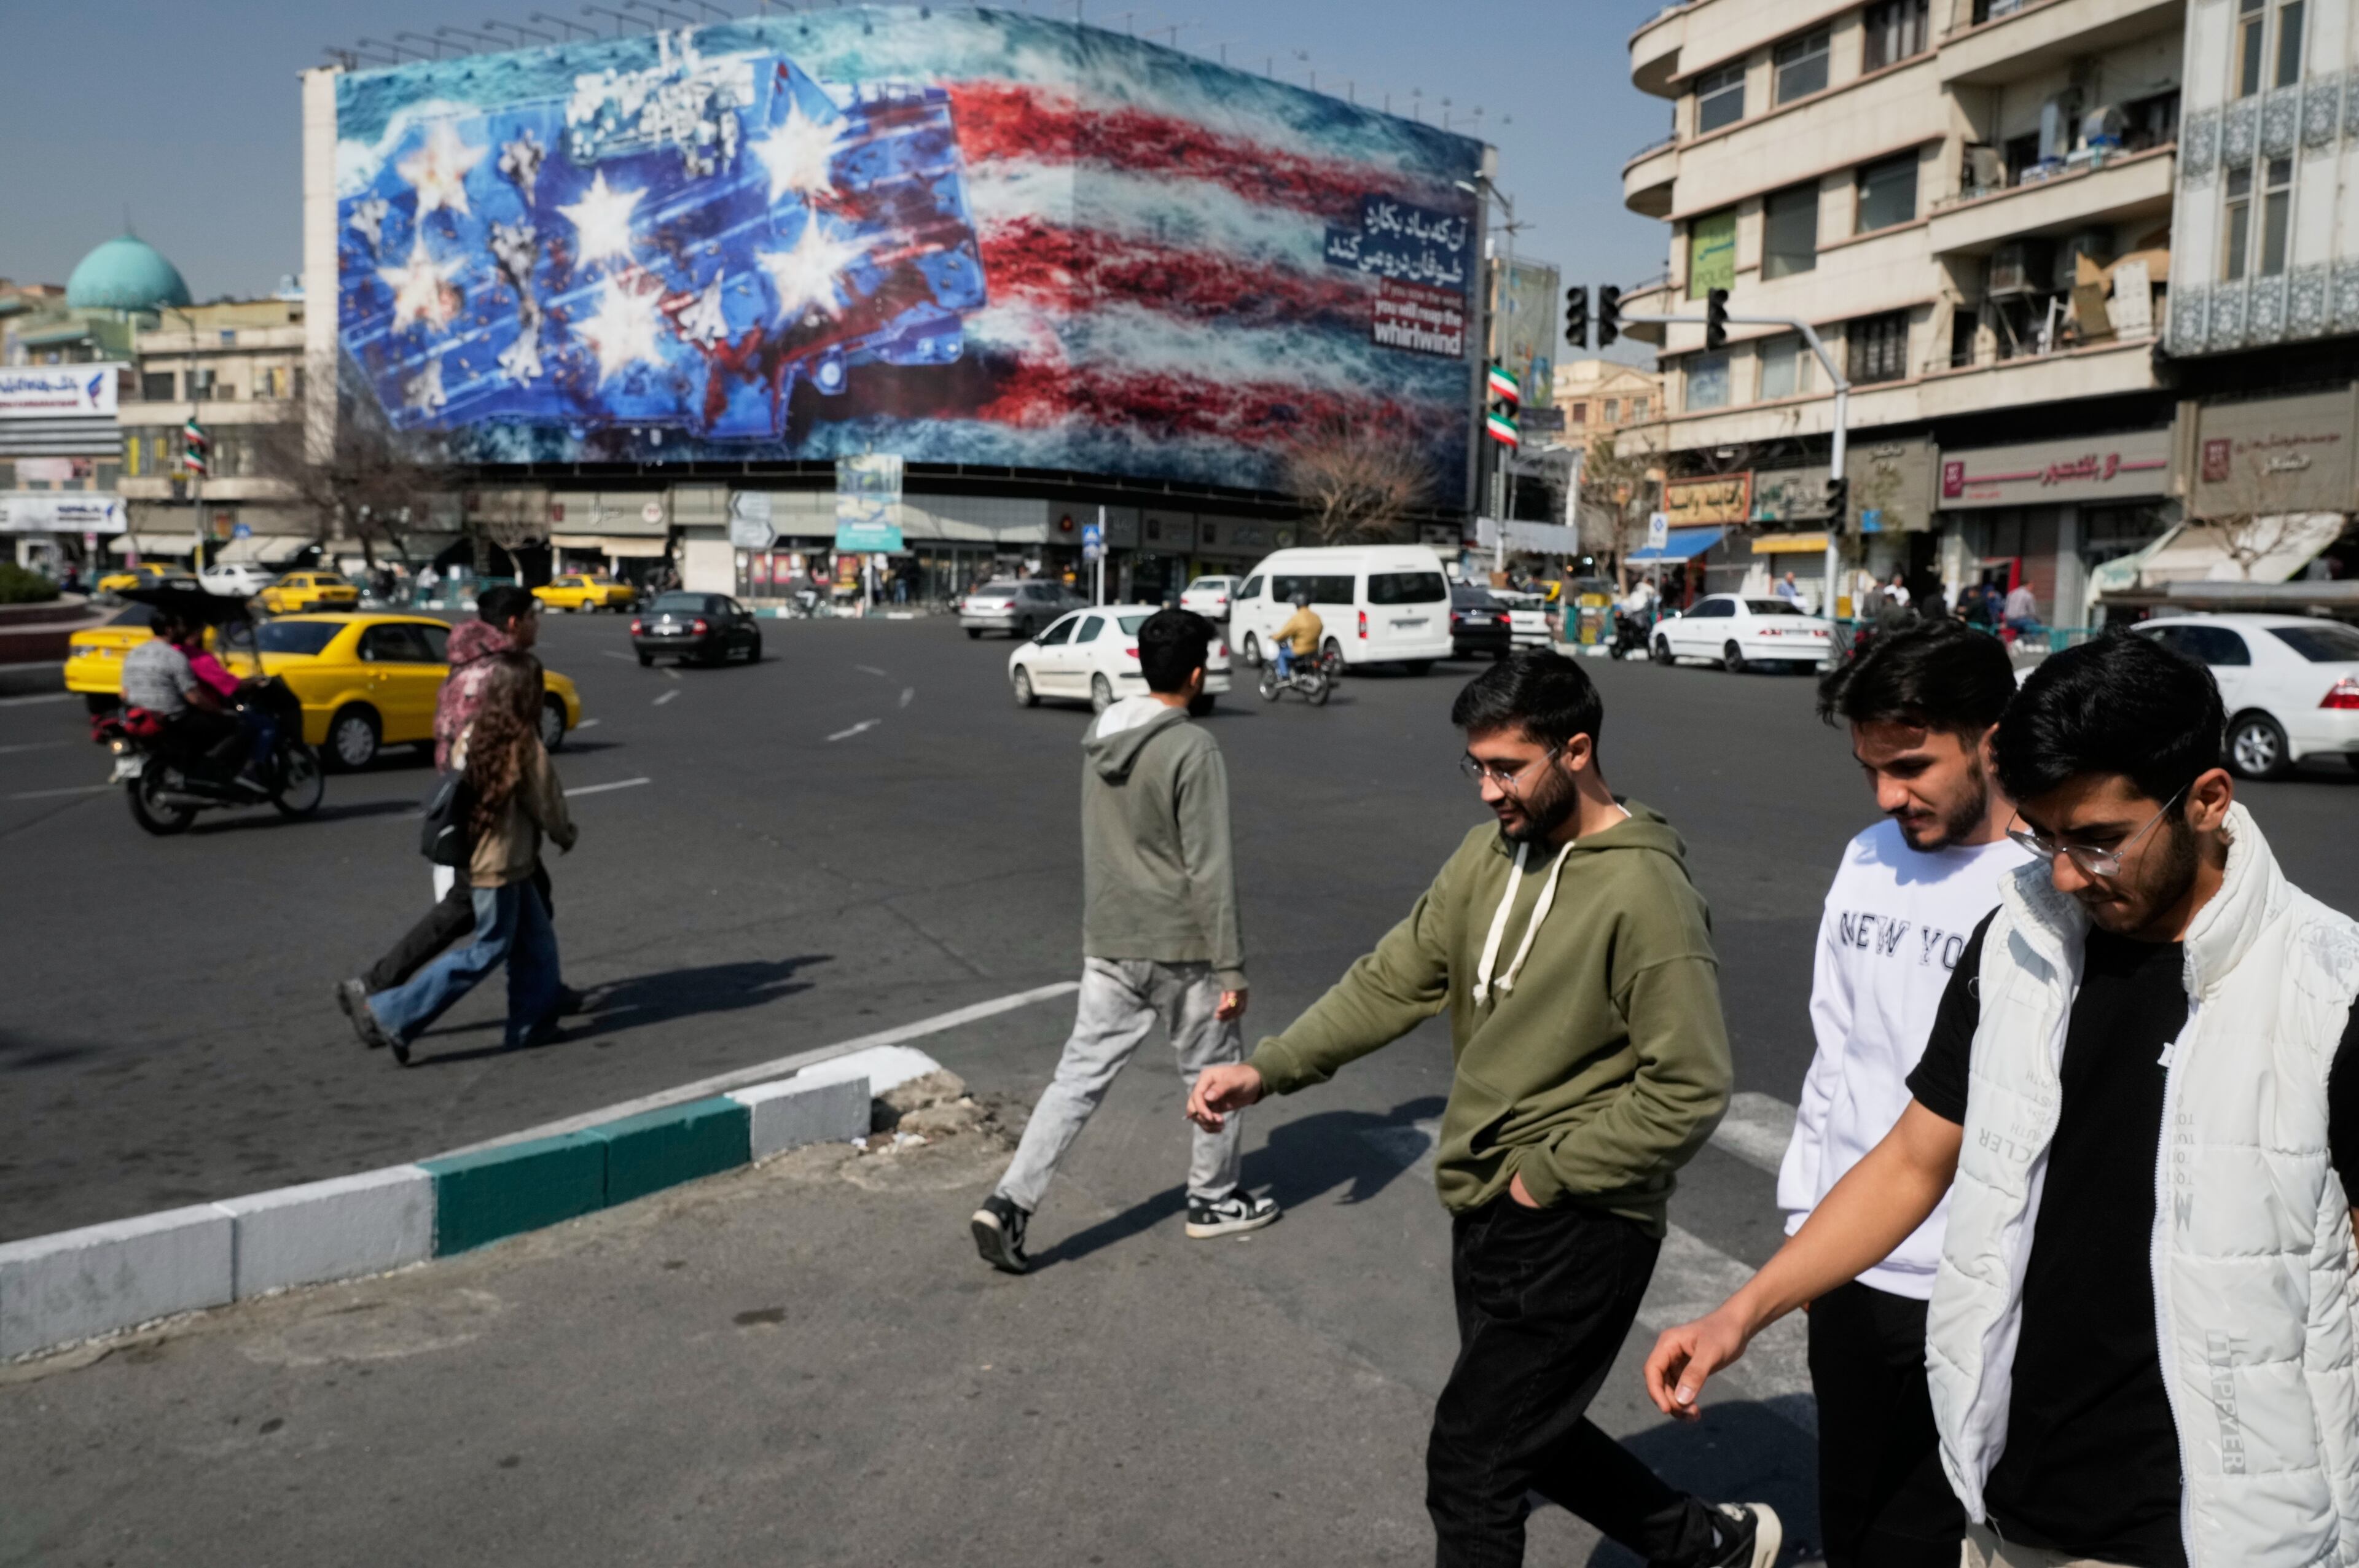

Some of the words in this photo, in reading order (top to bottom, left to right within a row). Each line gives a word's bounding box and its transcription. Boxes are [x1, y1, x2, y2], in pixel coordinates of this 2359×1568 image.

[1408, 249, 1464, 287] طوفان
[1374, 299, 1398, 316] you
[1444, 308, 1463, 328] the
[1374, 318, 1463, 356] whirlwind
[1840, 910, 1911, 957] NEW
[1917, 925, 1966, 973] YO
